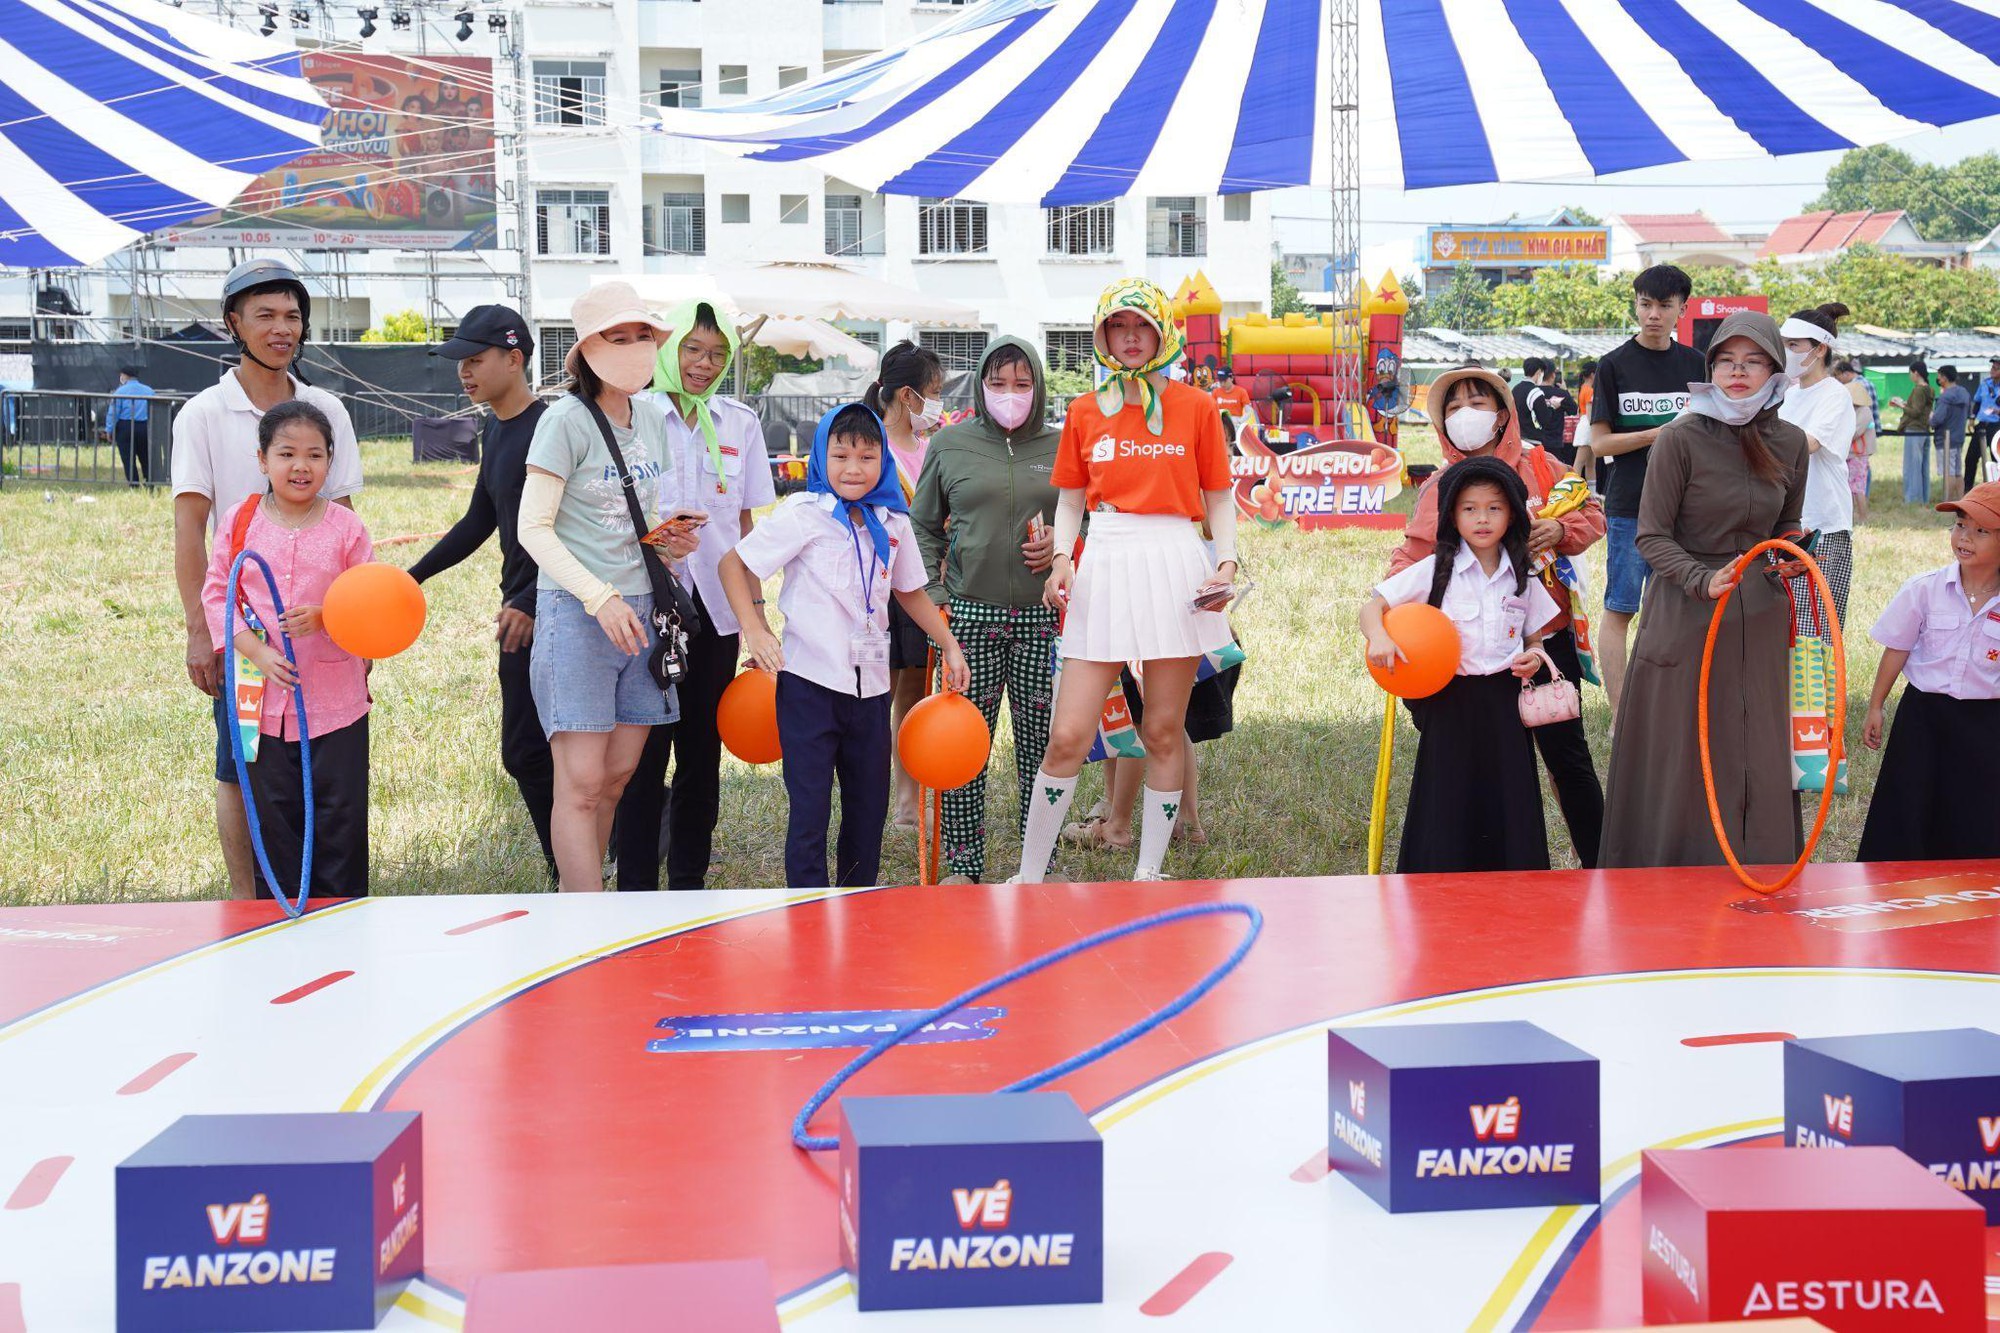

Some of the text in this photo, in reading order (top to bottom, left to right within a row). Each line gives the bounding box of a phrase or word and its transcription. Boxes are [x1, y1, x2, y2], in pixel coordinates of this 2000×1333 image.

[240, 232, 271, 243] 10.05
[1527, 238, 1549, 255] KIM
[1553, 238, 1571, 255] GIA
[1575, 234, 1606, 255] PHÁT
[1119, 440, 1186, 460] Shopee
[1230, 455, 1374, 478] KHU VUI CHƠI
[1281, 477, 1385, 515] TRẺ EM
[1807, 886, 2000, 920] OUCHER
[1349, 1080, 1366, 1120] VÉ
[1469, 1096, 1521, 1141] VÉ
[1824, 1094, 1853, 1136] VÉ
[1334, 1110, 1382, 1168] FANZONE
[1415, 1144, 1575, 1178] FANZONE
[206, 1193, 270, 1244] VÉ
[952, 1179, 1013, 1229] VÉ
[380, 1202, 419, 1275] FANZONE
[890, 1233, 1075, 1271] FANZONE
[143, 1249, 336, 1290] FANZONE
[1650, 1223, 1700, 1304] AESTURA
[1743, 1280, 1944, 1317] AESTURA
